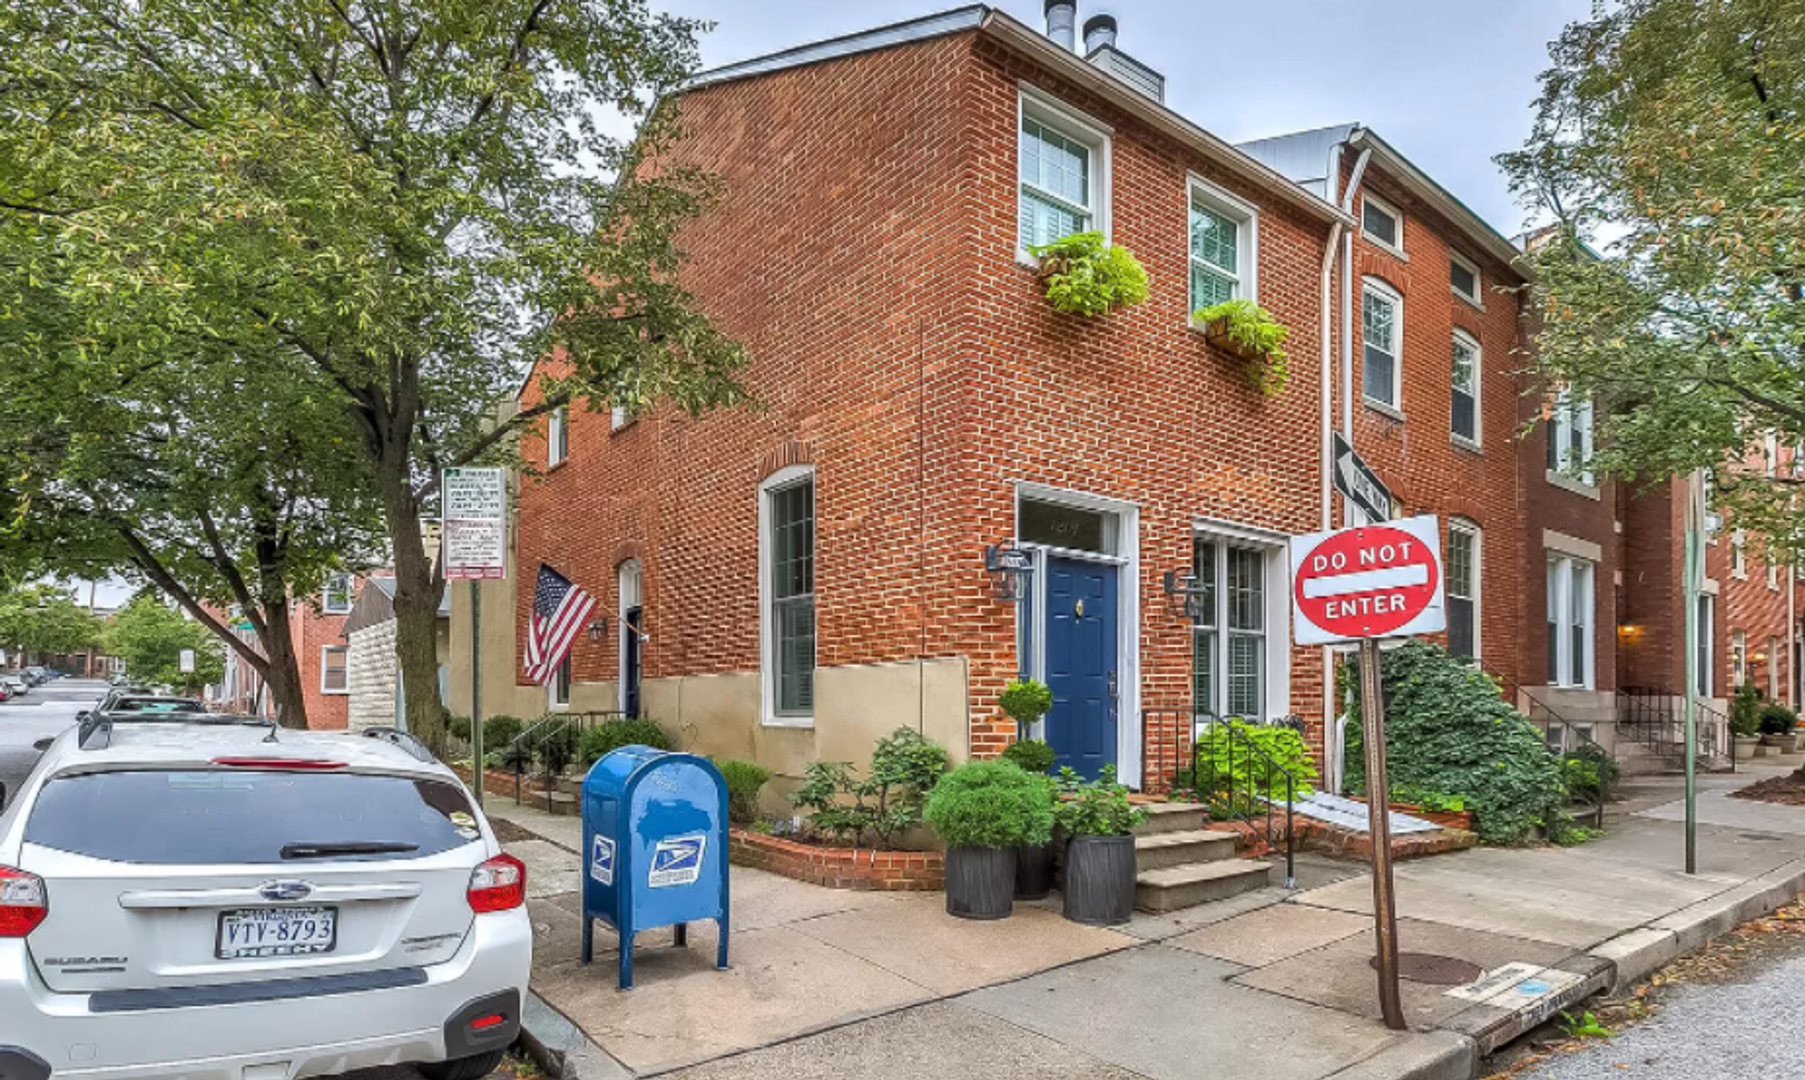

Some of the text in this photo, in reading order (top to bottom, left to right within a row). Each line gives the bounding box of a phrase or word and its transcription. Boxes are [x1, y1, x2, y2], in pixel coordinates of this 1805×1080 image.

[1313, 541, 1413, 572] DO NOT
[1325, 594, 1406, 618] ENTER
[228, 920, 331, 944] VTV-8793
[43, 956, 128, 966] SUBARU
